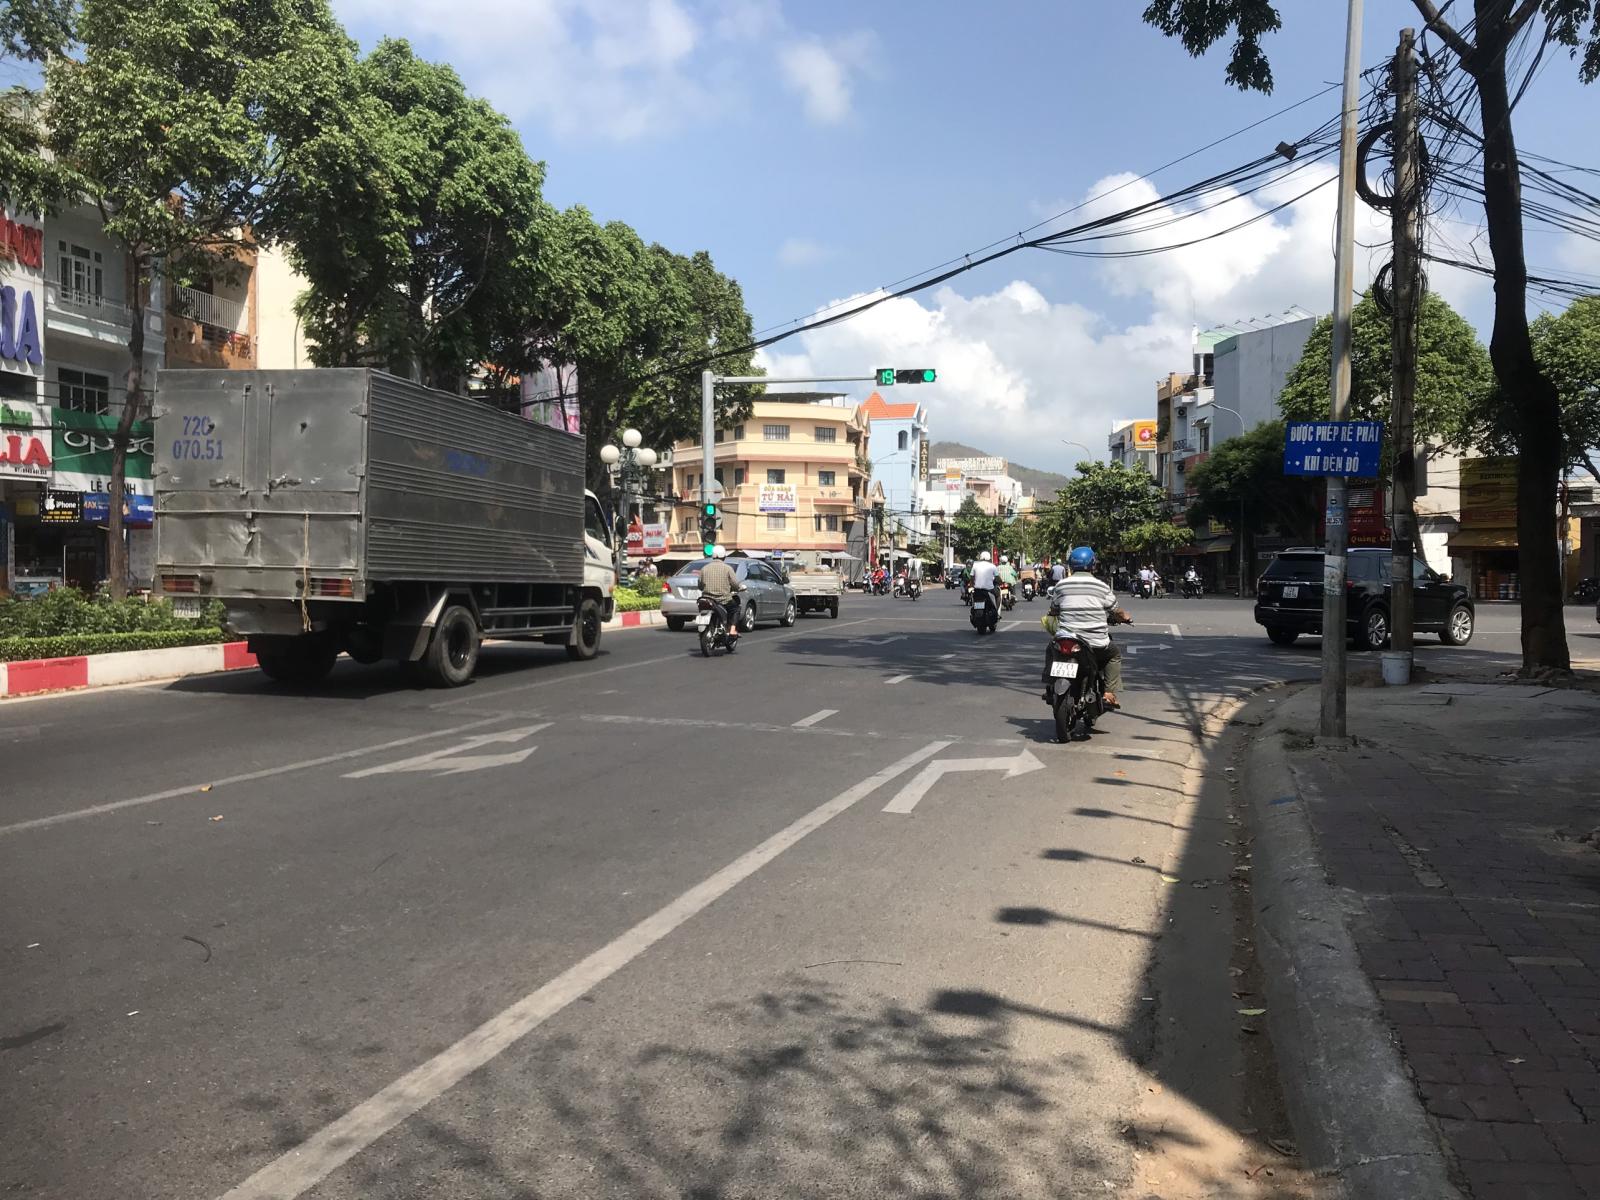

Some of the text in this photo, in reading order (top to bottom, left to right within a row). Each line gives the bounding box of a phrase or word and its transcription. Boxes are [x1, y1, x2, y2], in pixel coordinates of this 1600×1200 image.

[0, 285, 43, 365] IA
[882, 370, 894, 384] 19
[1290, 424, 1314, 444] ĐƯỢC
[1316, 424, 1339, 442] PHÉP
[1356, 422, 1379, 442] PHẢI
[0, 435, 51, 466] IA
[172, 440, 224, 460] 070.51
[1304, 456, 1320, 471] KHI
[1346, 451, 1360, 473] ĐỎ
[56, 501, 76, 509] iPhone
